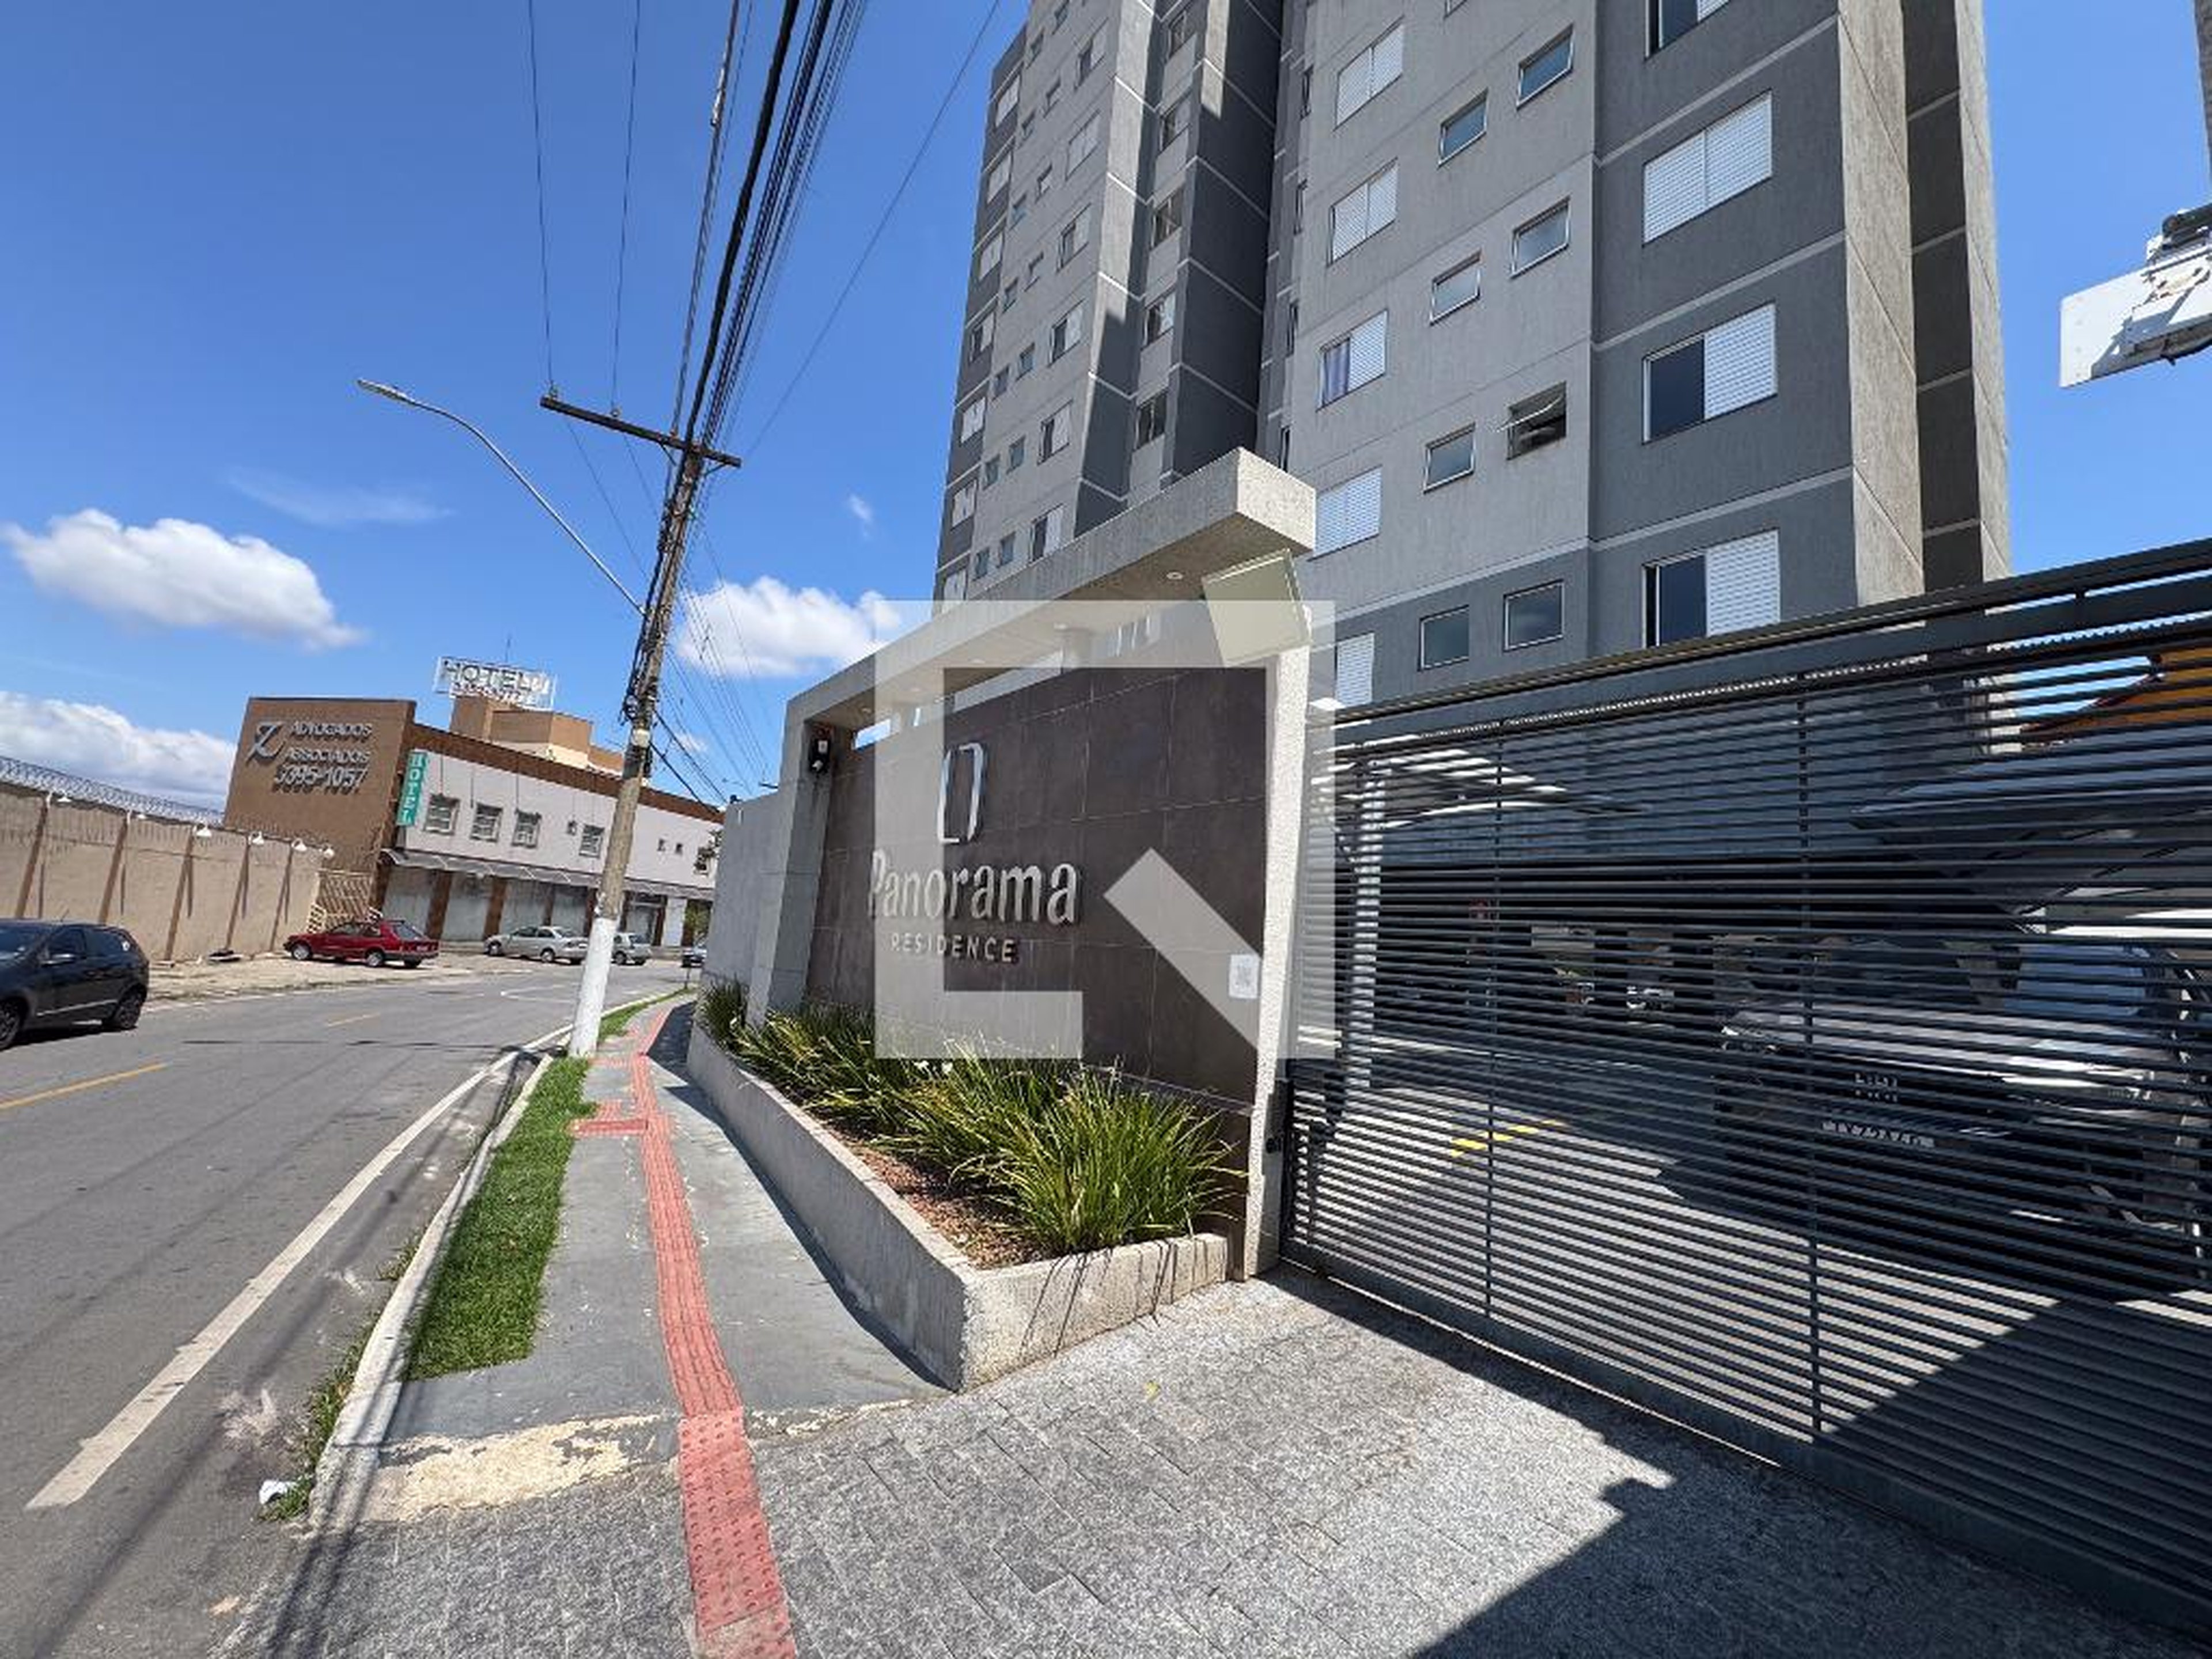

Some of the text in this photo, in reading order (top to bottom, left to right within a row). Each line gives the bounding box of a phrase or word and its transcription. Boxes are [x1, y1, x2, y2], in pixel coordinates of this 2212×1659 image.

[440, 659, 533, 693] HOTEL
[290, 720, 373, 737] ADVOGADOS
[285, 748, 371, 763] ASSOCIADOS
[402, 753, 425, 824] HOTEL
[868, 848, 1078, 926] Panorama
[891, 932, 1016, 963] RESIDENCE
